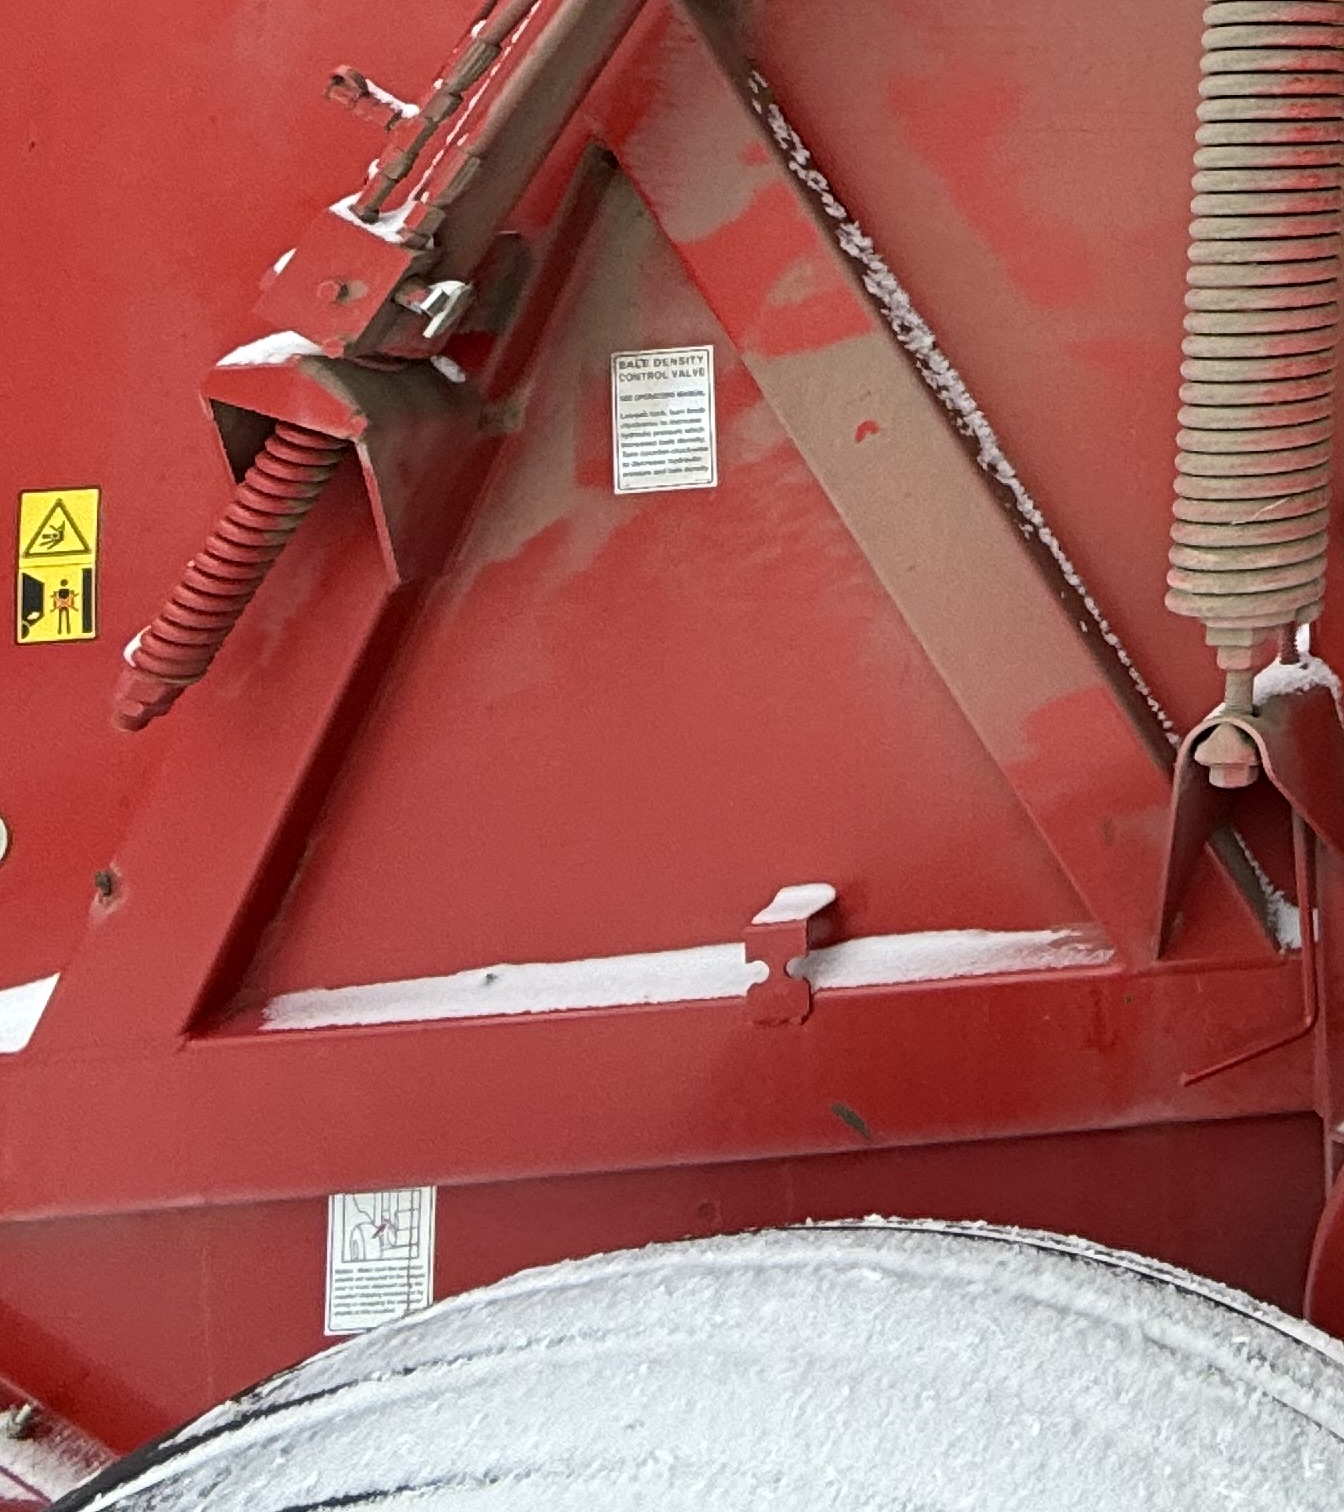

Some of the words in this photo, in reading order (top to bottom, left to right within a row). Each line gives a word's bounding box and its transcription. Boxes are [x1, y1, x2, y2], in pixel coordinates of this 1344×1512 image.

[653, 355, 704, 367] DENSITY
[619, 371, 668, 382] CONTROL
[671, 367, 705, 378] VALVE
